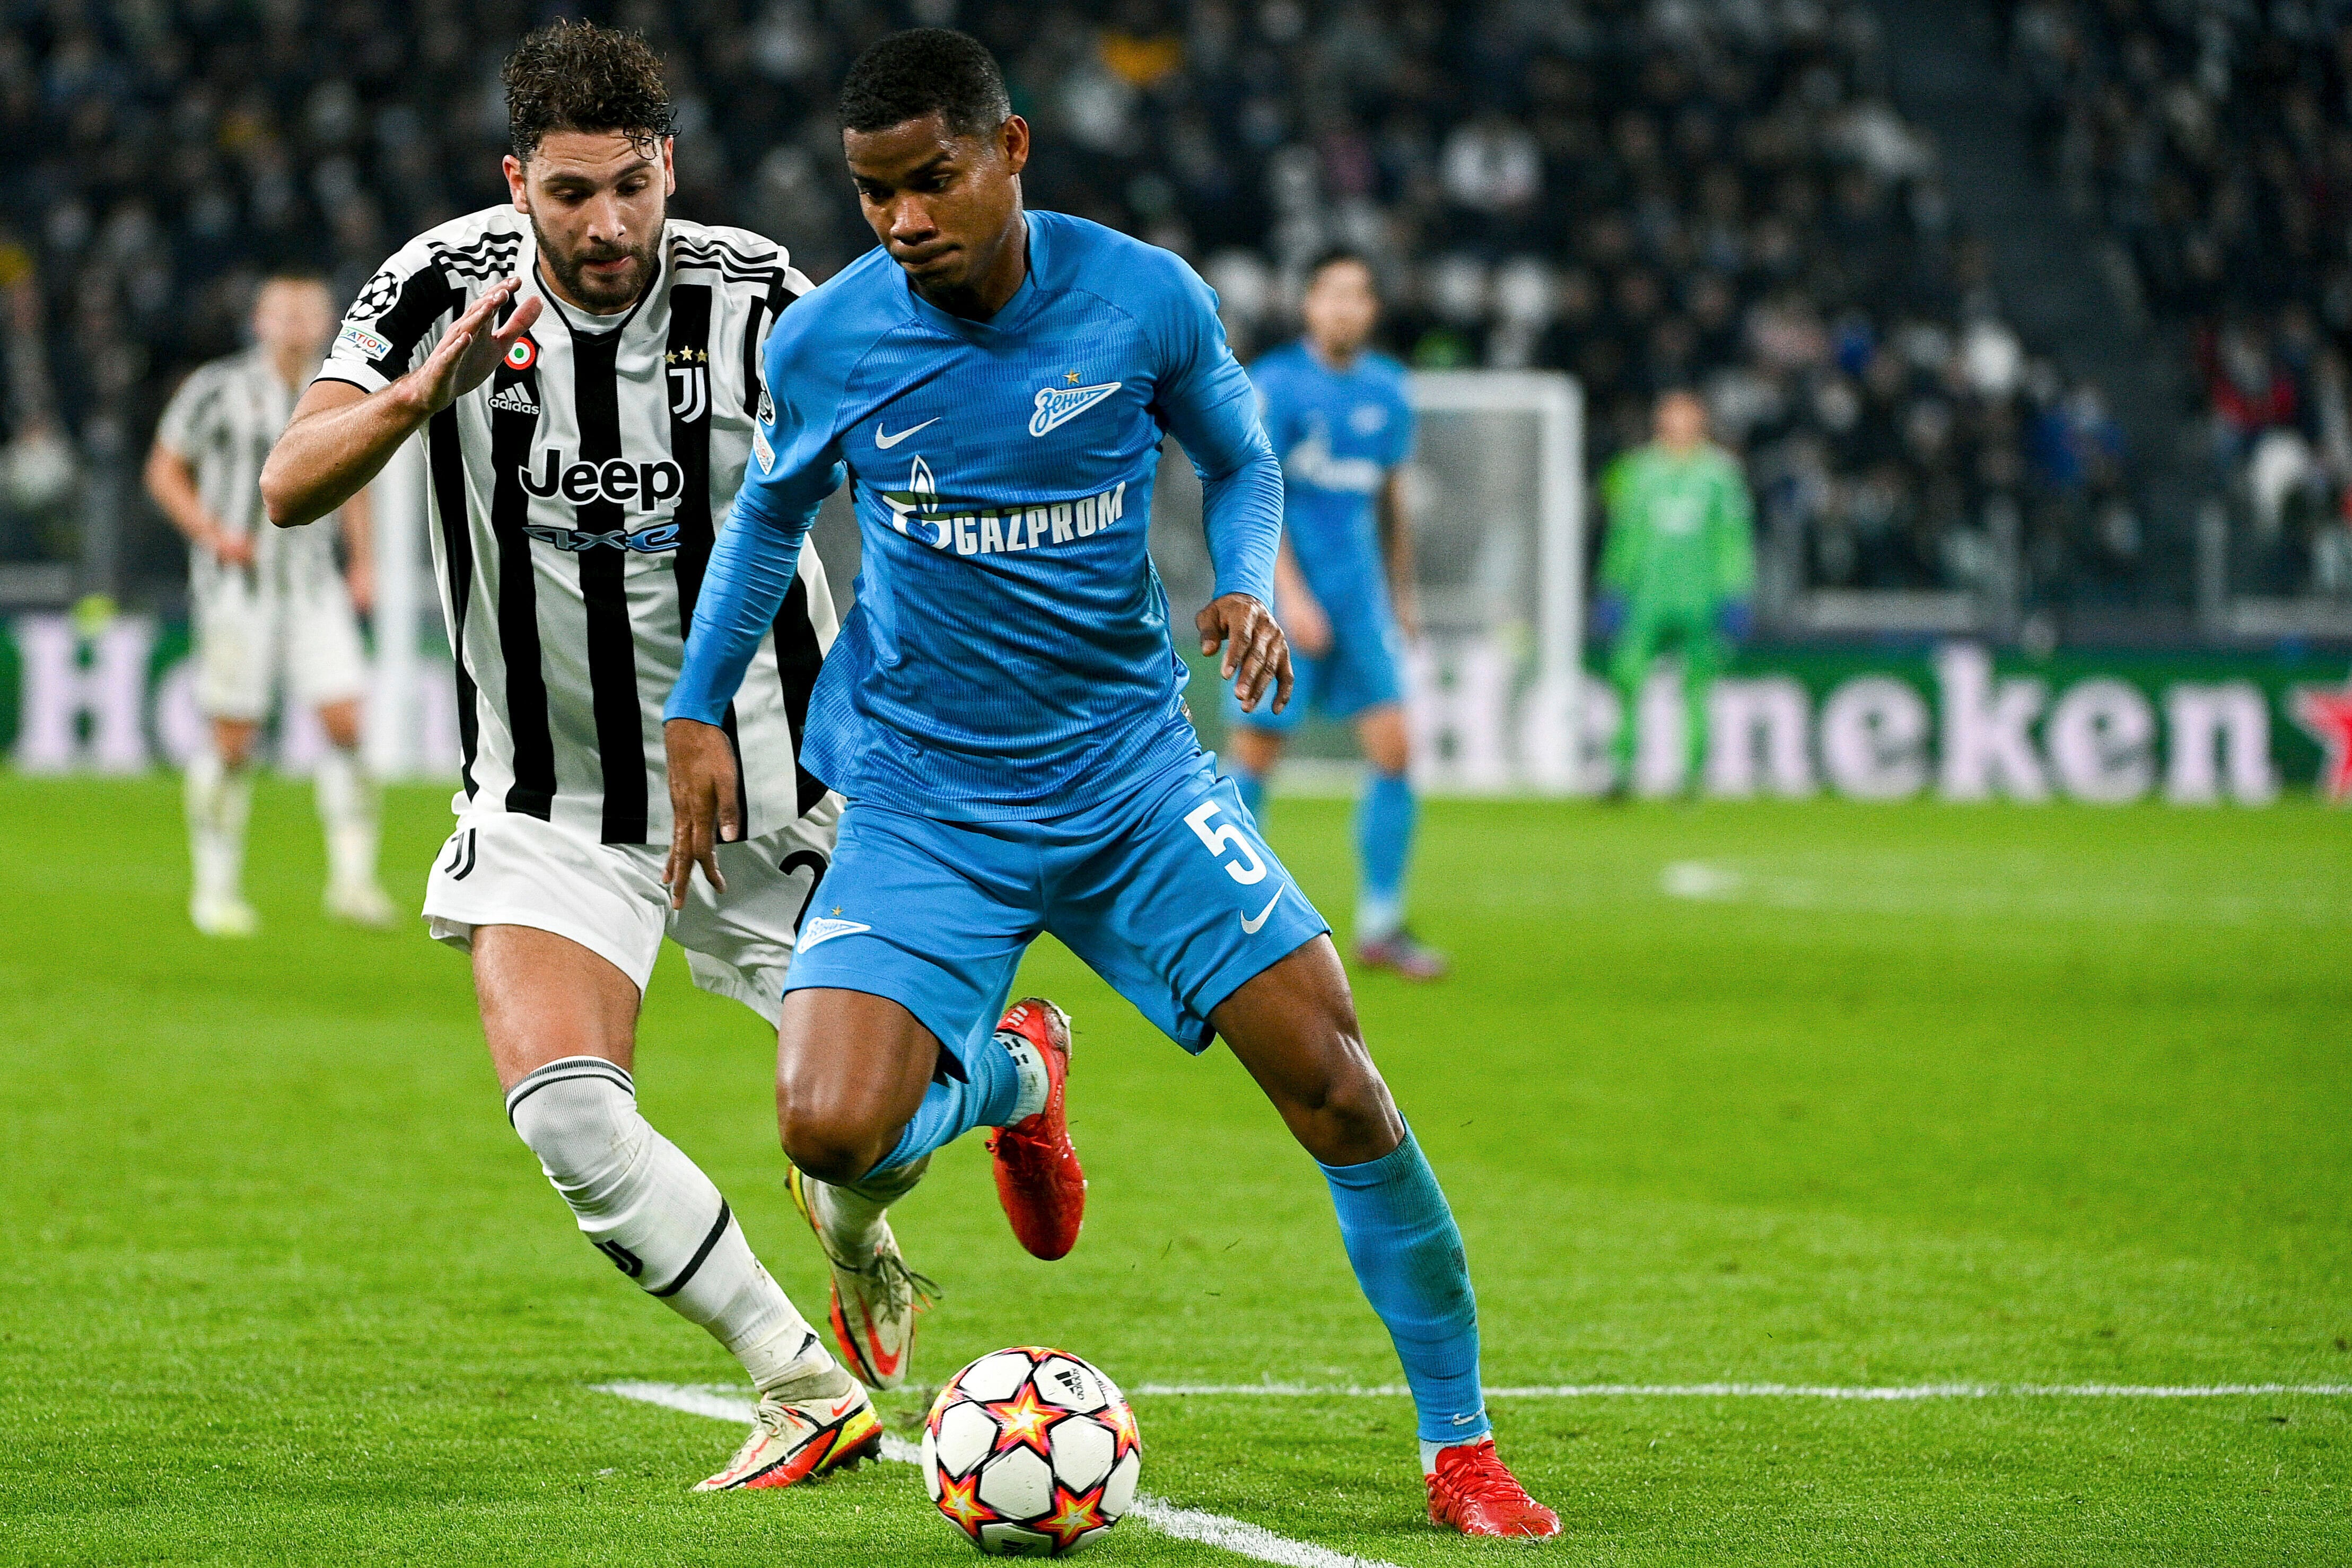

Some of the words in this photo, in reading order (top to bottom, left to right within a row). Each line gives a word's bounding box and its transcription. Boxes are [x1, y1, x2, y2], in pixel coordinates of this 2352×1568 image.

[489, 398, 540, 415] adidas
[518, 446, 685, 515] Jeep
[954, 480, 1126, 556] GAZPROM
[1183, 800, 1267, 885] 5
